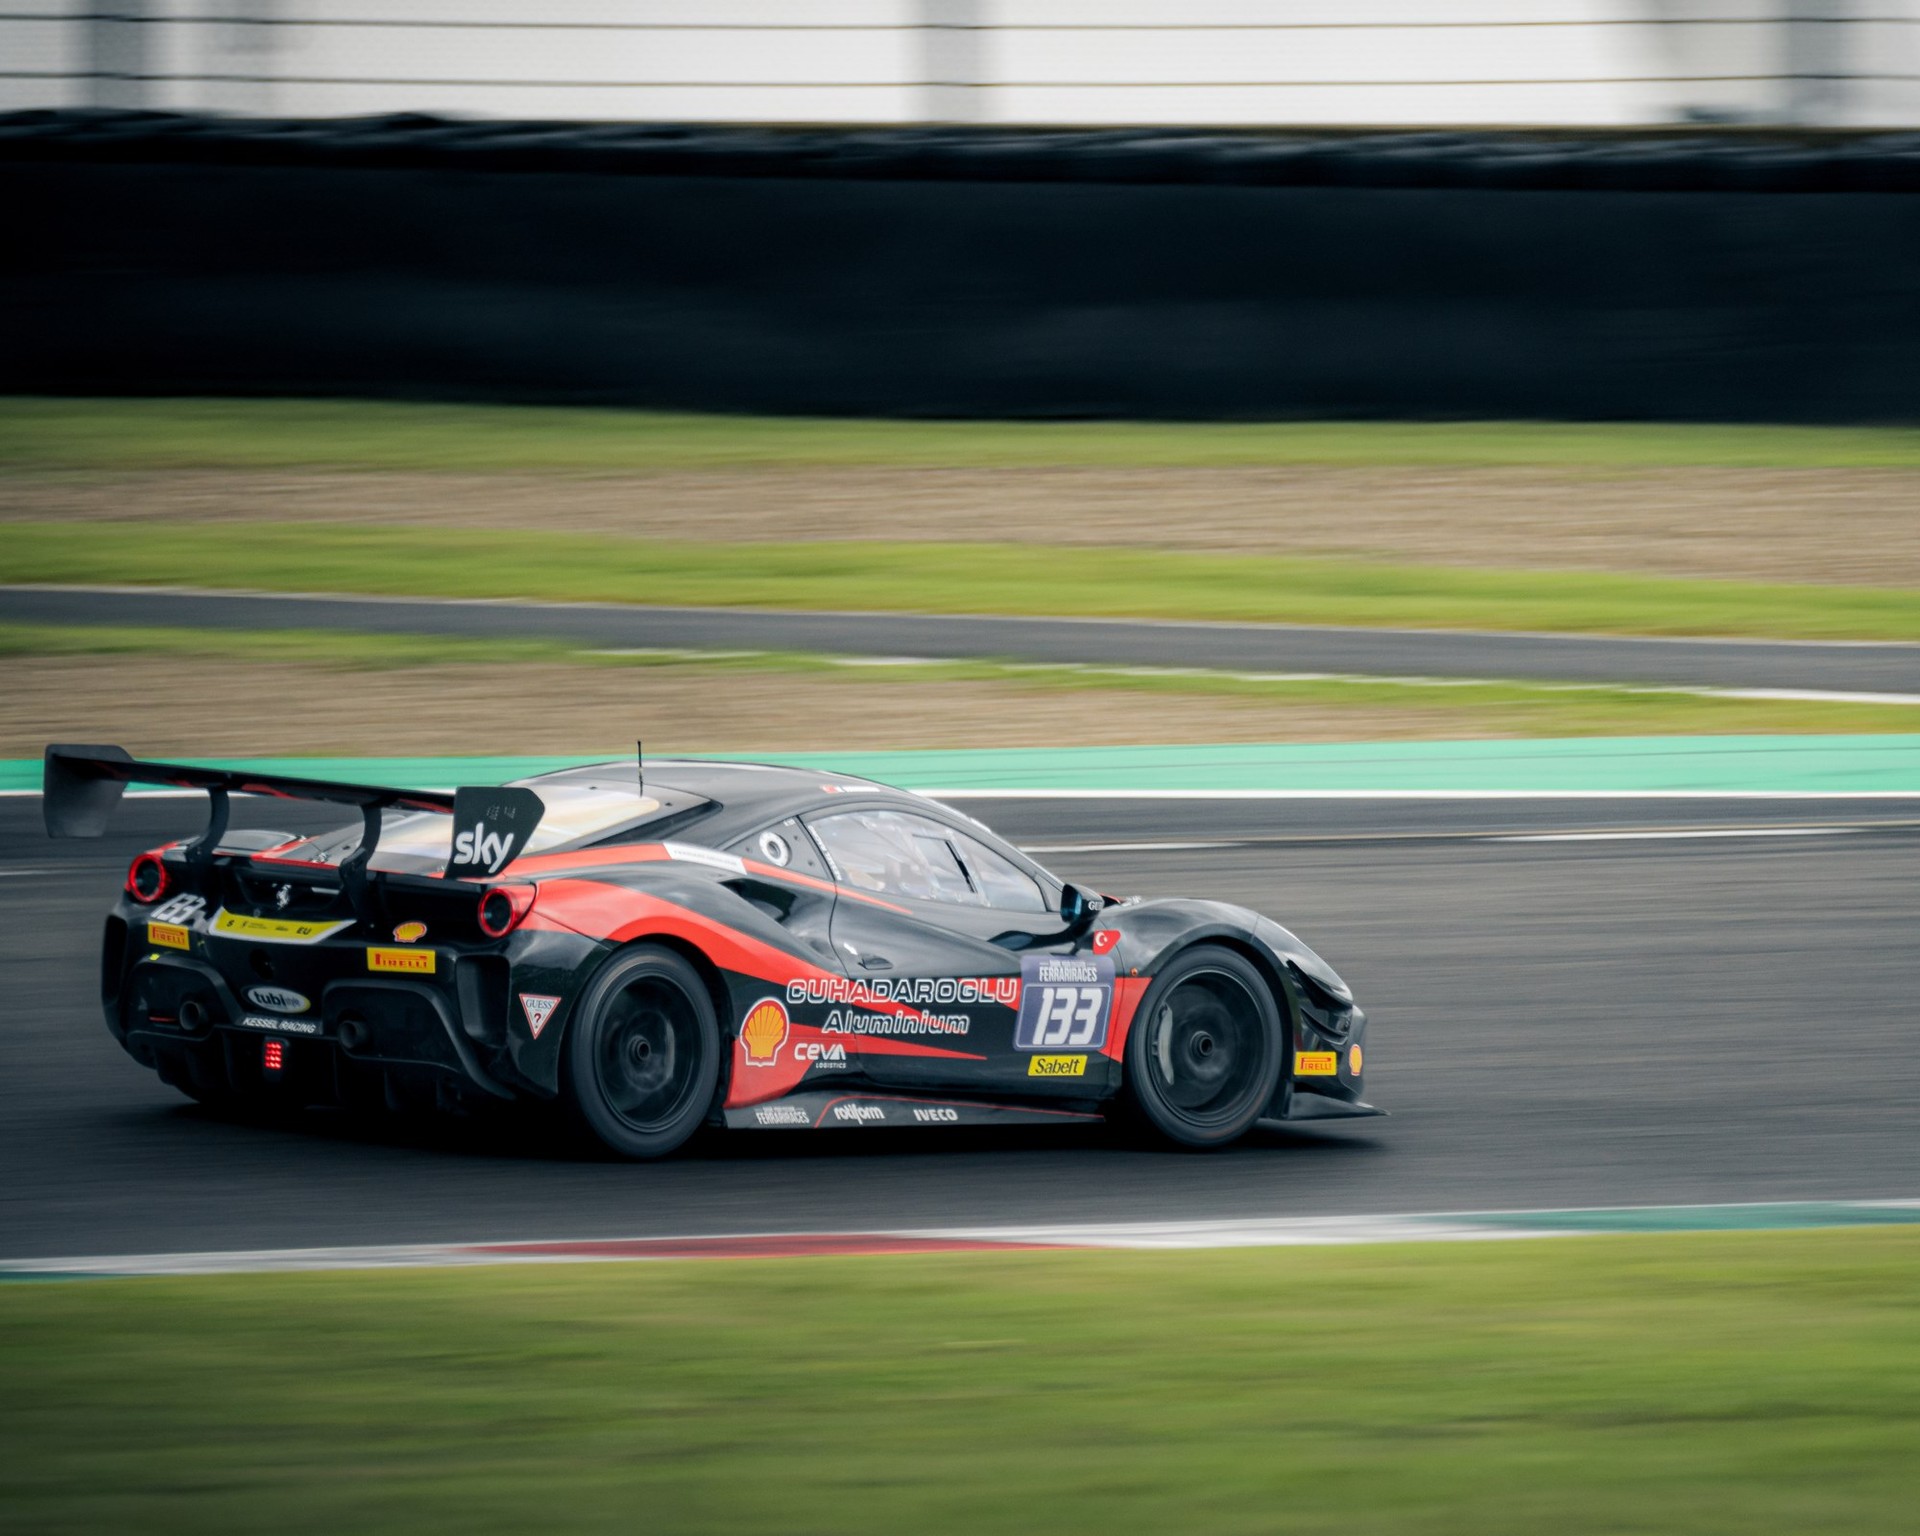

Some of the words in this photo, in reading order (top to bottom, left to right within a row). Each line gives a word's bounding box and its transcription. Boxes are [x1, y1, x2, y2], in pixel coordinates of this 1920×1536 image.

[453, 822, 514, 874] sky
[150, 893, 206, 925] 133
[152, 926, 185, 945] PIRELLI
[296, 926, 312, 936] EU
[375, 953, 428, 969] PIRELLI
[786, 978, 1018, 1004] CUHADAROGLU
[525, 999, 552, 1010] GUESS
[242, 1017, 279, 1030] KESSEL
[279, 1020, 317, 1034] RACING
[821, 1010, 970, 1034] Aluminium
[1032, 987, 1103, 1046] 133
[1034, 1058, 1081, 1075] Sabelt
[1300, 1057, 1332, 1071] PIRELLI
[834, 1103, 886, 1125] rotiform
[913, 1109, 959, 1121] IVECO
